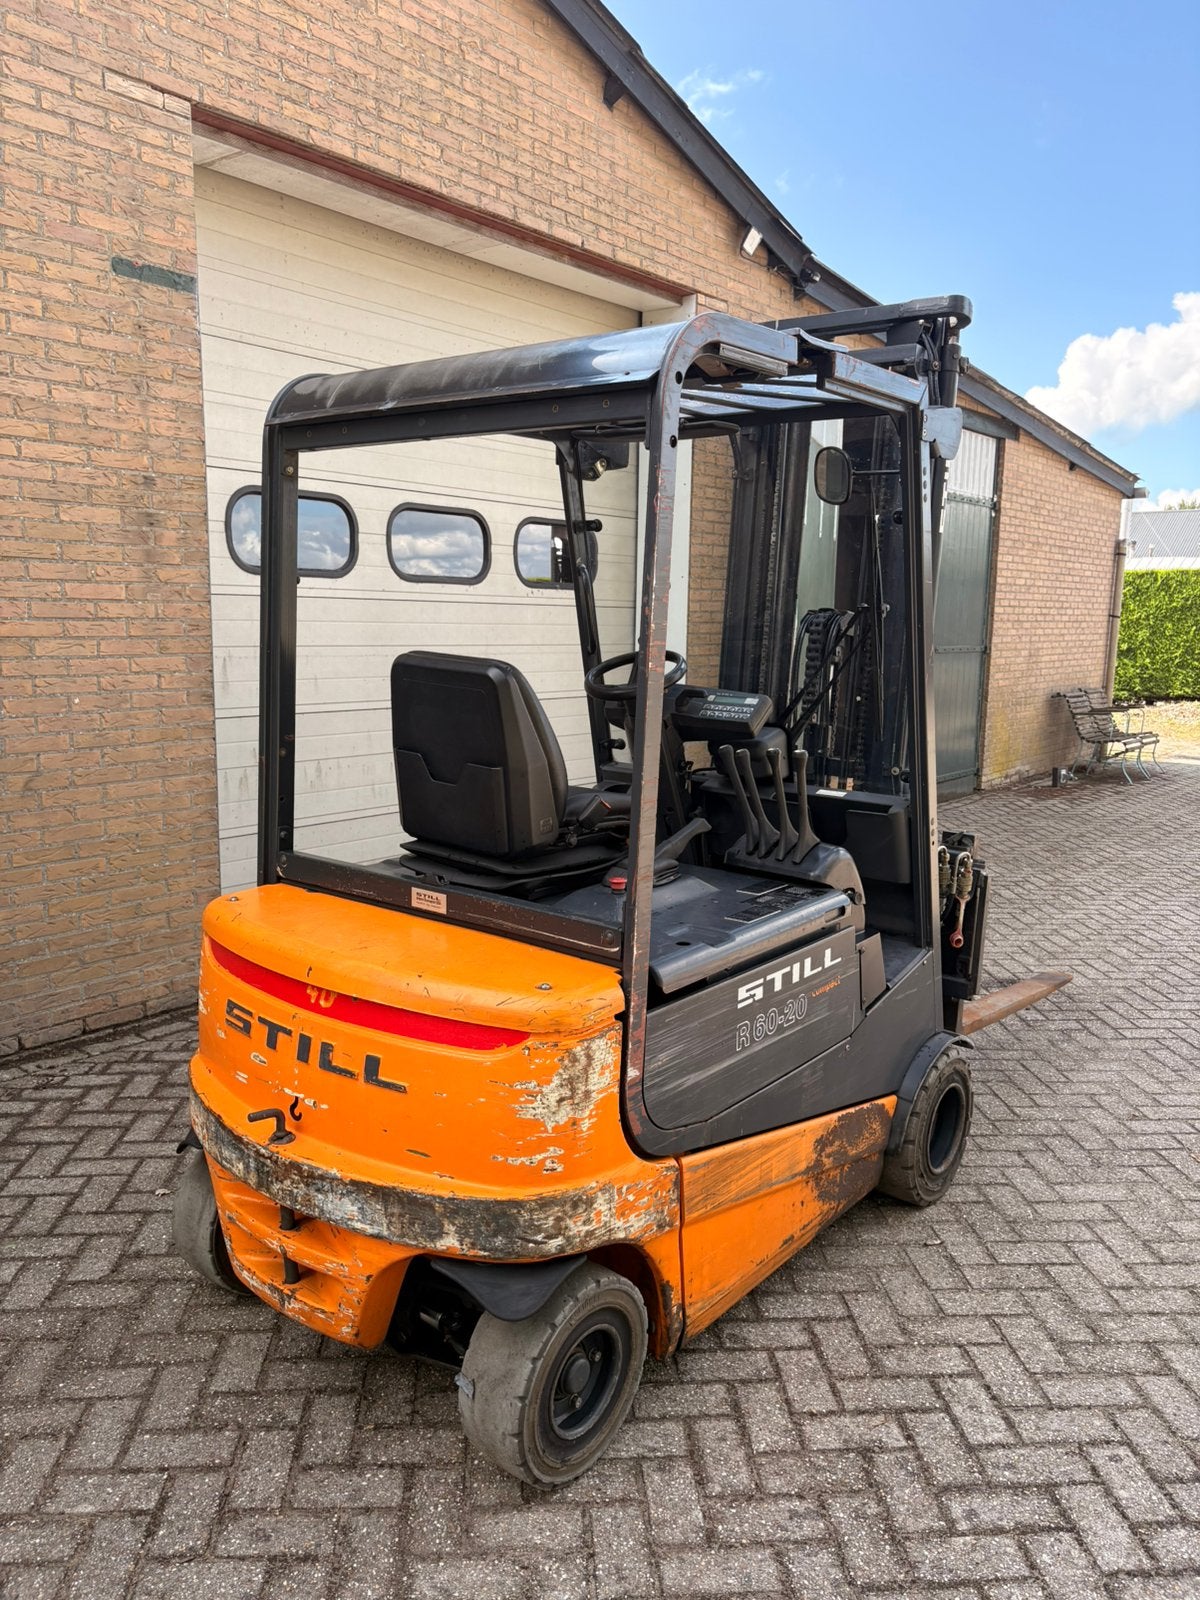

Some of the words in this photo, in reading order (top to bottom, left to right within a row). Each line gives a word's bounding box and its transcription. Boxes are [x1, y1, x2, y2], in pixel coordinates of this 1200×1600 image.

[416, 891, 440, 901] STILL
[737, 947, 842, 1009] STILL
[225, 998, 409, 1094] STILL
[736, 1020, 751, 1051] R
[753, 993, 808, 1041] 60-20
